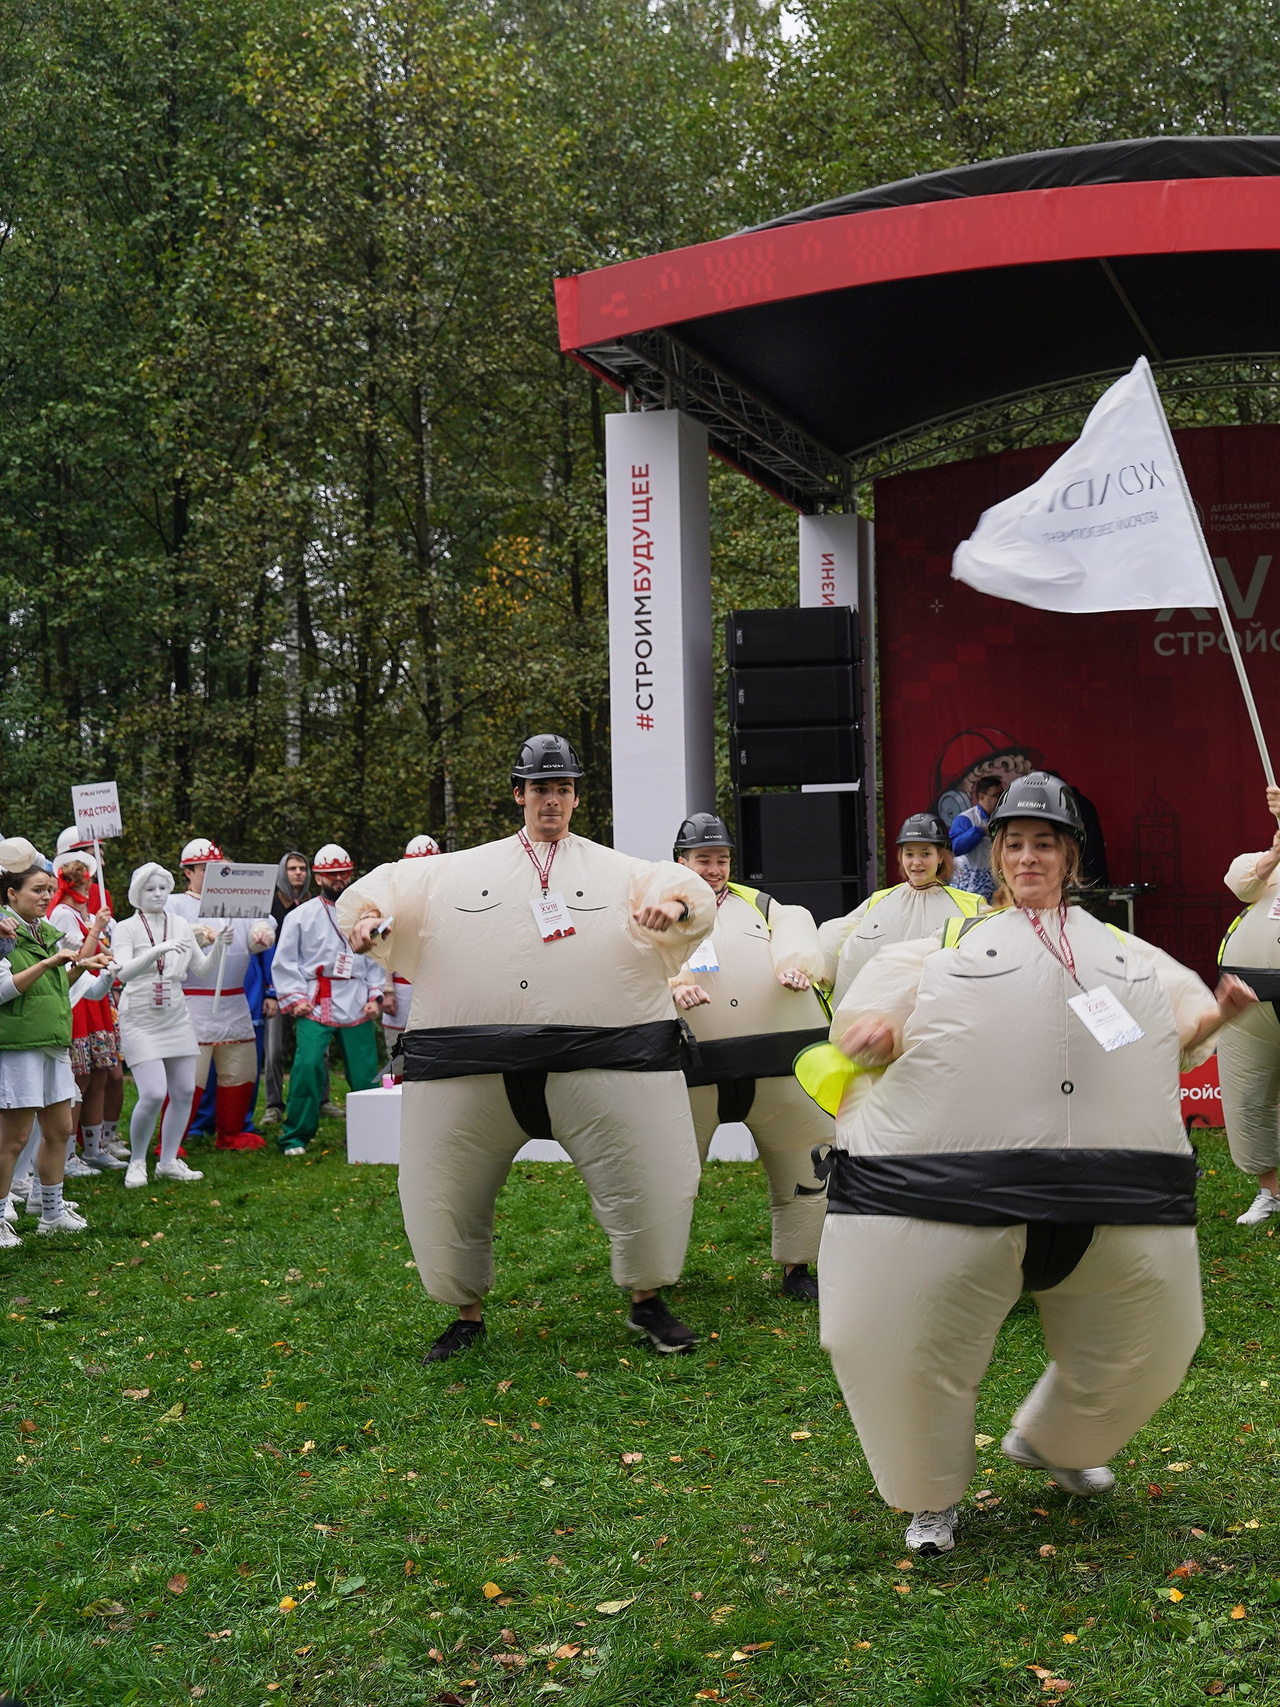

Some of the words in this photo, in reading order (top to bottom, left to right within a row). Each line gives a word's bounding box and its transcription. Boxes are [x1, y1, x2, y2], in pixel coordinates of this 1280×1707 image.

[1210, 502, 1271, 512] ДЕПАРТАМЕНТ
[1210, 523, 1247, 532] ГОРОДА
[631, 463, 655, 732] #СТРОИМБУДУЩЕЕ
[206, 887, 272, 896] МОСГОРГЕОТРЕСТ
